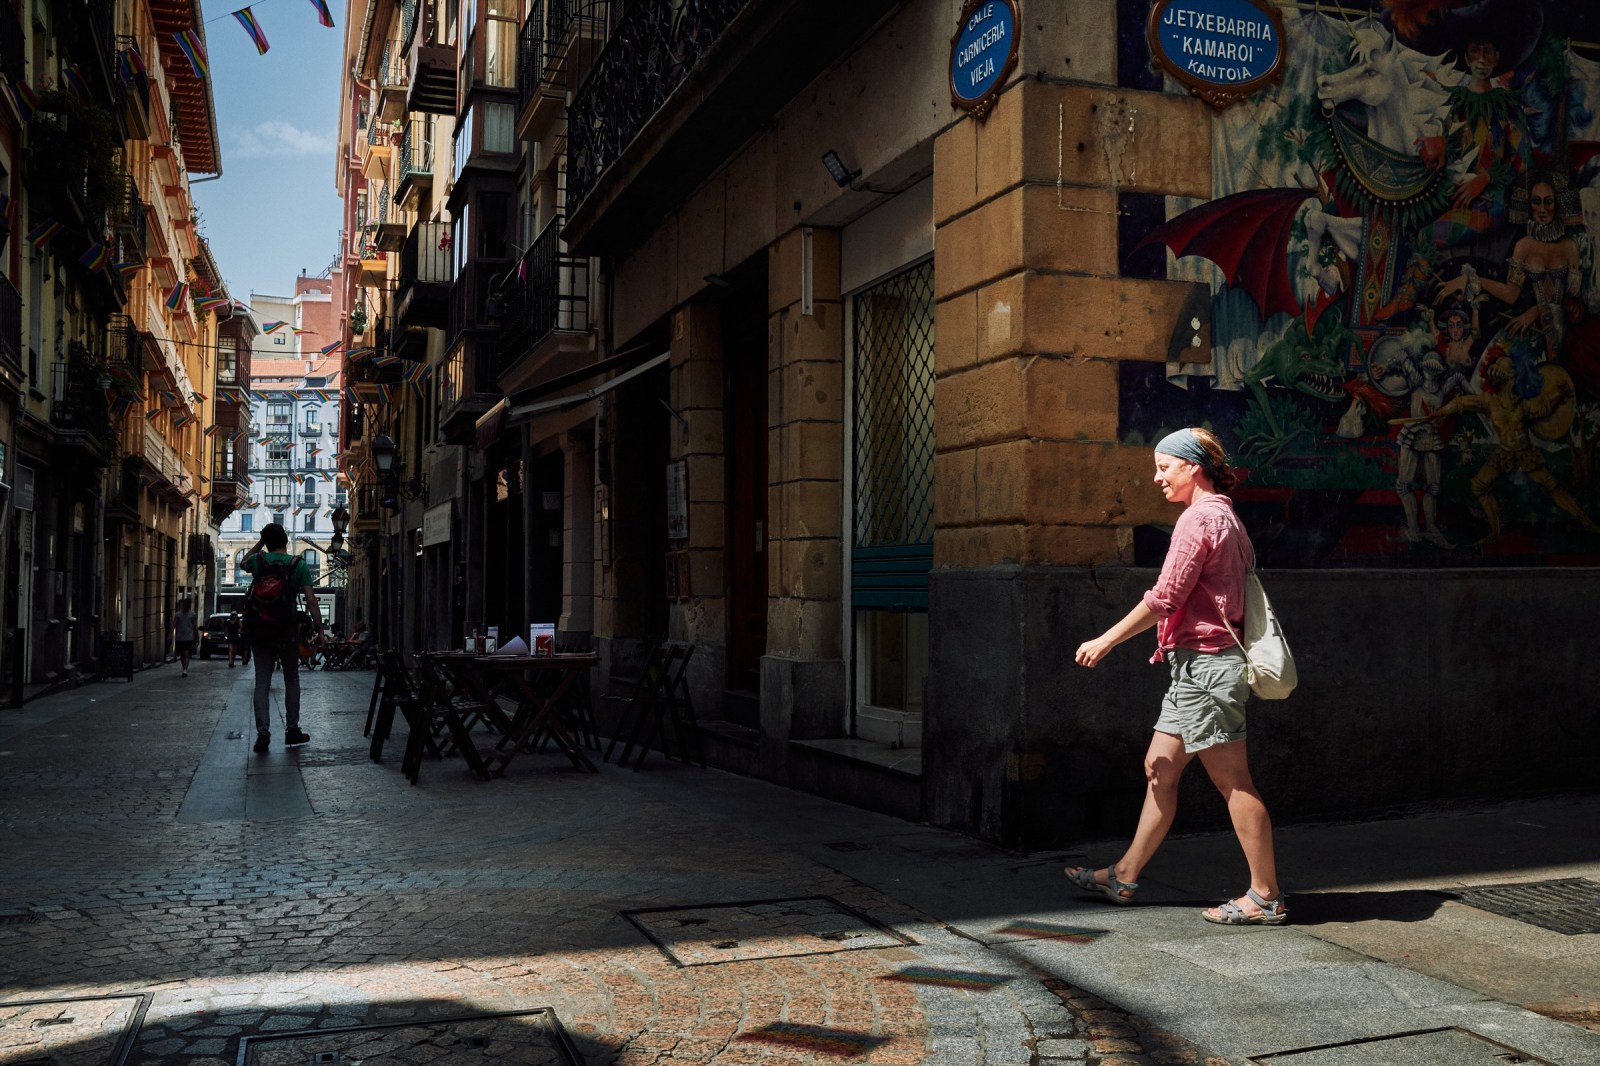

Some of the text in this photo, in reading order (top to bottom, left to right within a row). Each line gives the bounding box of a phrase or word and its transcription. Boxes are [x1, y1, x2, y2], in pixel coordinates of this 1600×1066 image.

[968, 4, 994, 31] CALLE
[958, 20, 1005, 68] CARNICERIA
[970, 57, 994, 87] VIEJA
[1187, 59, 1252, 81] KANTOIA
